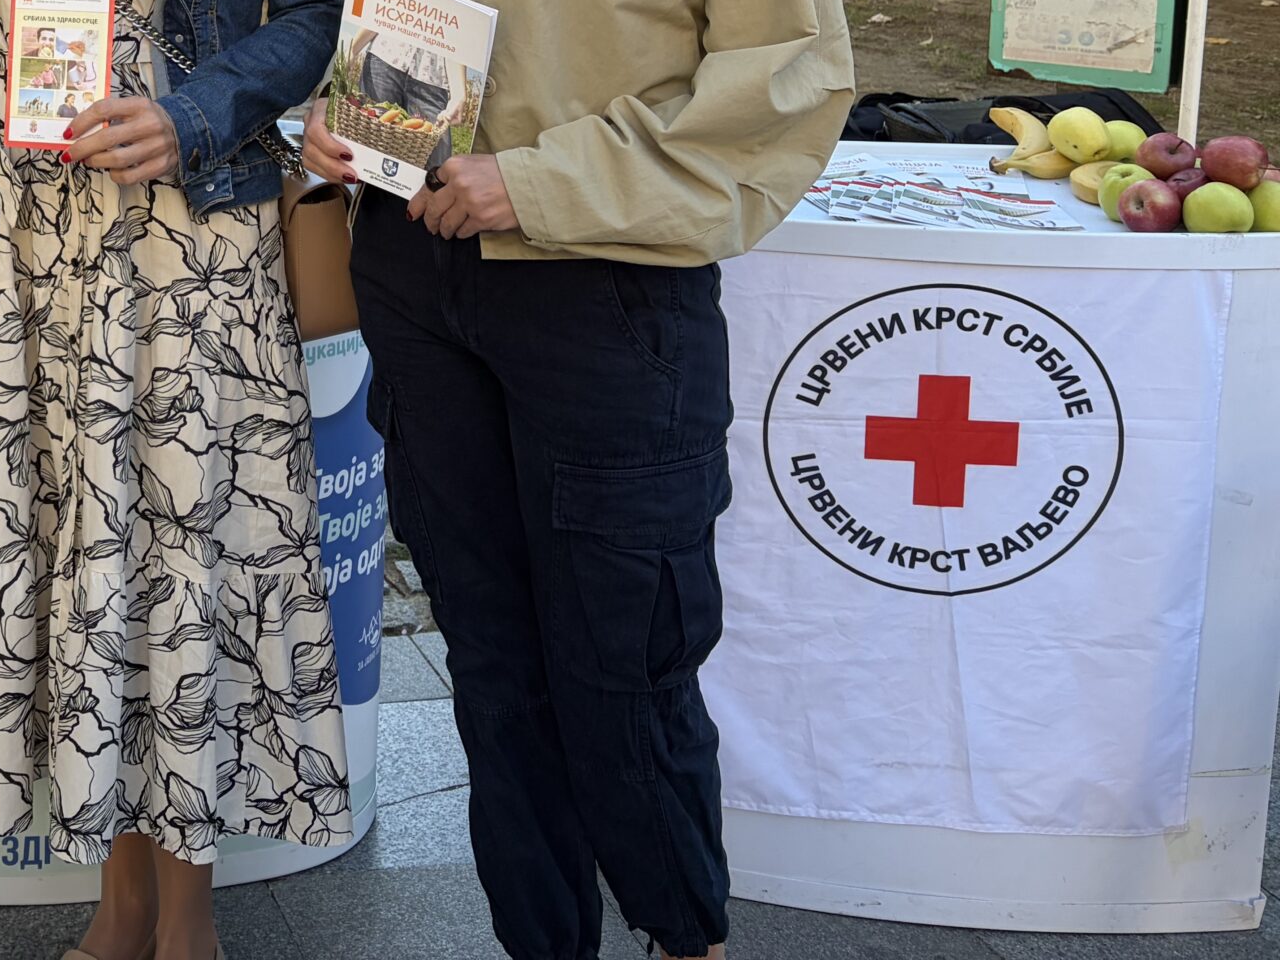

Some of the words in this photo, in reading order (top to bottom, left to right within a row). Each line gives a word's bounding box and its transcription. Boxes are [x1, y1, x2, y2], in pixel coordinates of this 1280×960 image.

[23, 15, 47, 23] СРБИЈА
[47, 15, 56, 23] ЗА
[56, 16, 82, 25] ЗДРАВО
[82, 17, 99, 25] СРЦЕ
[374, 18, 397, 31] чувар
[397, 26, 421, 39] нашег
[375, 3, 446, 40] ИСХРАНА
[795, 311, 908, 408] ЦРВЕНИ
[912, 306, 1004, 337] КРСТ
[1001, 322, 1095, 419] СРБИЈЕ
[790, 452, 886, 557] ЦРВЕНИ
[887, 541, 971, 573] КРСТ
[974, 464, 1090, 569] ВАЉЕВО
